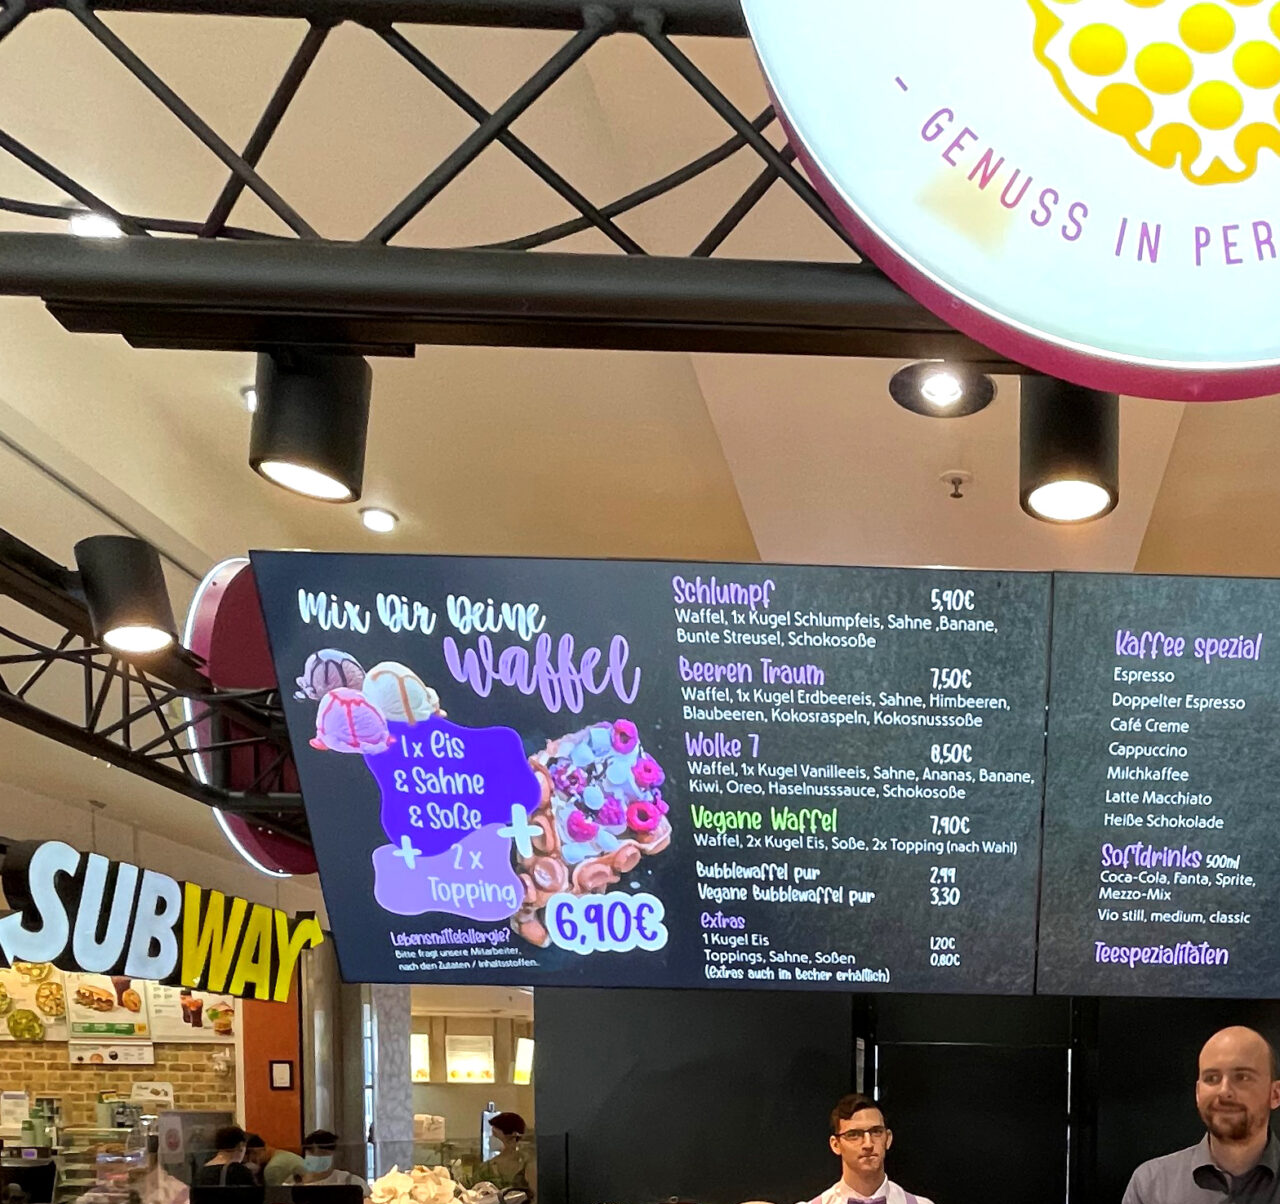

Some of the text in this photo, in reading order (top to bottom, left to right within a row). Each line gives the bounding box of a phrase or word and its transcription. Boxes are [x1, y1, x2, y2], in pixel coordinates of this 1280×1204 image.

[920, 107, 1089, 242] GENUSS
[1114, 216, 1162, 264] IN
[672, 575, 975, 612] Schlumpf 5,90€
[298, 588, 547, 641] Mix Dir Deine
[674, 608, 933, 631] Waffel, Kugel Schlumpfeis, Sahne
[677, 628, 877, 649] Bunte Streusel, Schokosoße
[1115, 629, 1263, 664] Kaffee spezial
[443, 632, 642, 714] Waffel
[679, 655, 972, 691] Beeren Traum 7,50€
[1113, 666, 1175, 685] Espresso
[682, 686, 1011, 711] Waffel, Kugel Erdbeereis, Sahne, Himbeeren,
[1112, 692, 1246, 712] Doppelter Espresso
[683, 706, 983, 728] Blaubeeren, Kokosraspeln, Kokosnusssoße
[1110, 717, 1142, 732] Café
[1144, 718, 1190, 733] Creme
[432, 730, 466, 760] Eis
[685, 731, 973, 764] Wolke 7 8,50€
[1108, 741, 1188, 759] Cappuccino
[412, 767, 485, 796] Sahne
[687, 761, 1035, 785] Waffel, Kugel Vanilleeis, Sahne, Ananas, Banane,
[1107, 765, 1190, 782] Milchkaffee
[689, 779, 967, 800] Kiwi, Oreo, Haselnusssauce, Schokosoße
[1105, 789, 1213, 807] Latte Macchiato
[429, 803, 482, 830] Soße
[691, 804, 970, 836] Vegane Waffel 7,90€
[1104, 812, 1143, 827] Heiße
[1146, 813, 1225, 830] Schokolade
[693, 833, 1018, 856] Waffel, Kugel Eis, Soße, Topping (nach Wahl)
[1101, 840, 1203, 870] Softdrinks
[695, 860, 821, 884] Bubblewaffel pur
[1099, 870, 1257, 889] Coca-Cola, Fanta, Sprite,
[427, 876, 518, 909] Topping
[697, 882, 961, 906] Vegane Bubblewaffel pur 3,30
[1098, 887, 1172, 901] Mezzo-Mix
[0, 840, 325, 1004] SUBWAY
[555, 901, 659, 947] 6,90€
[1097, 908, 1119, 921] Vio
[1121, 908, 1148, 923] still,
[1150, 909, 1207, 924] medium,
[1209, 911, 1251, 924] classic
[711, 932, 770, 949] Kugel Eis
[703, 948, 856, 965] Toppings, Sahne, Soßen
[1094, 939, 1230, 969] Teespezialitäten
[747, 967, 775, 981] auch
